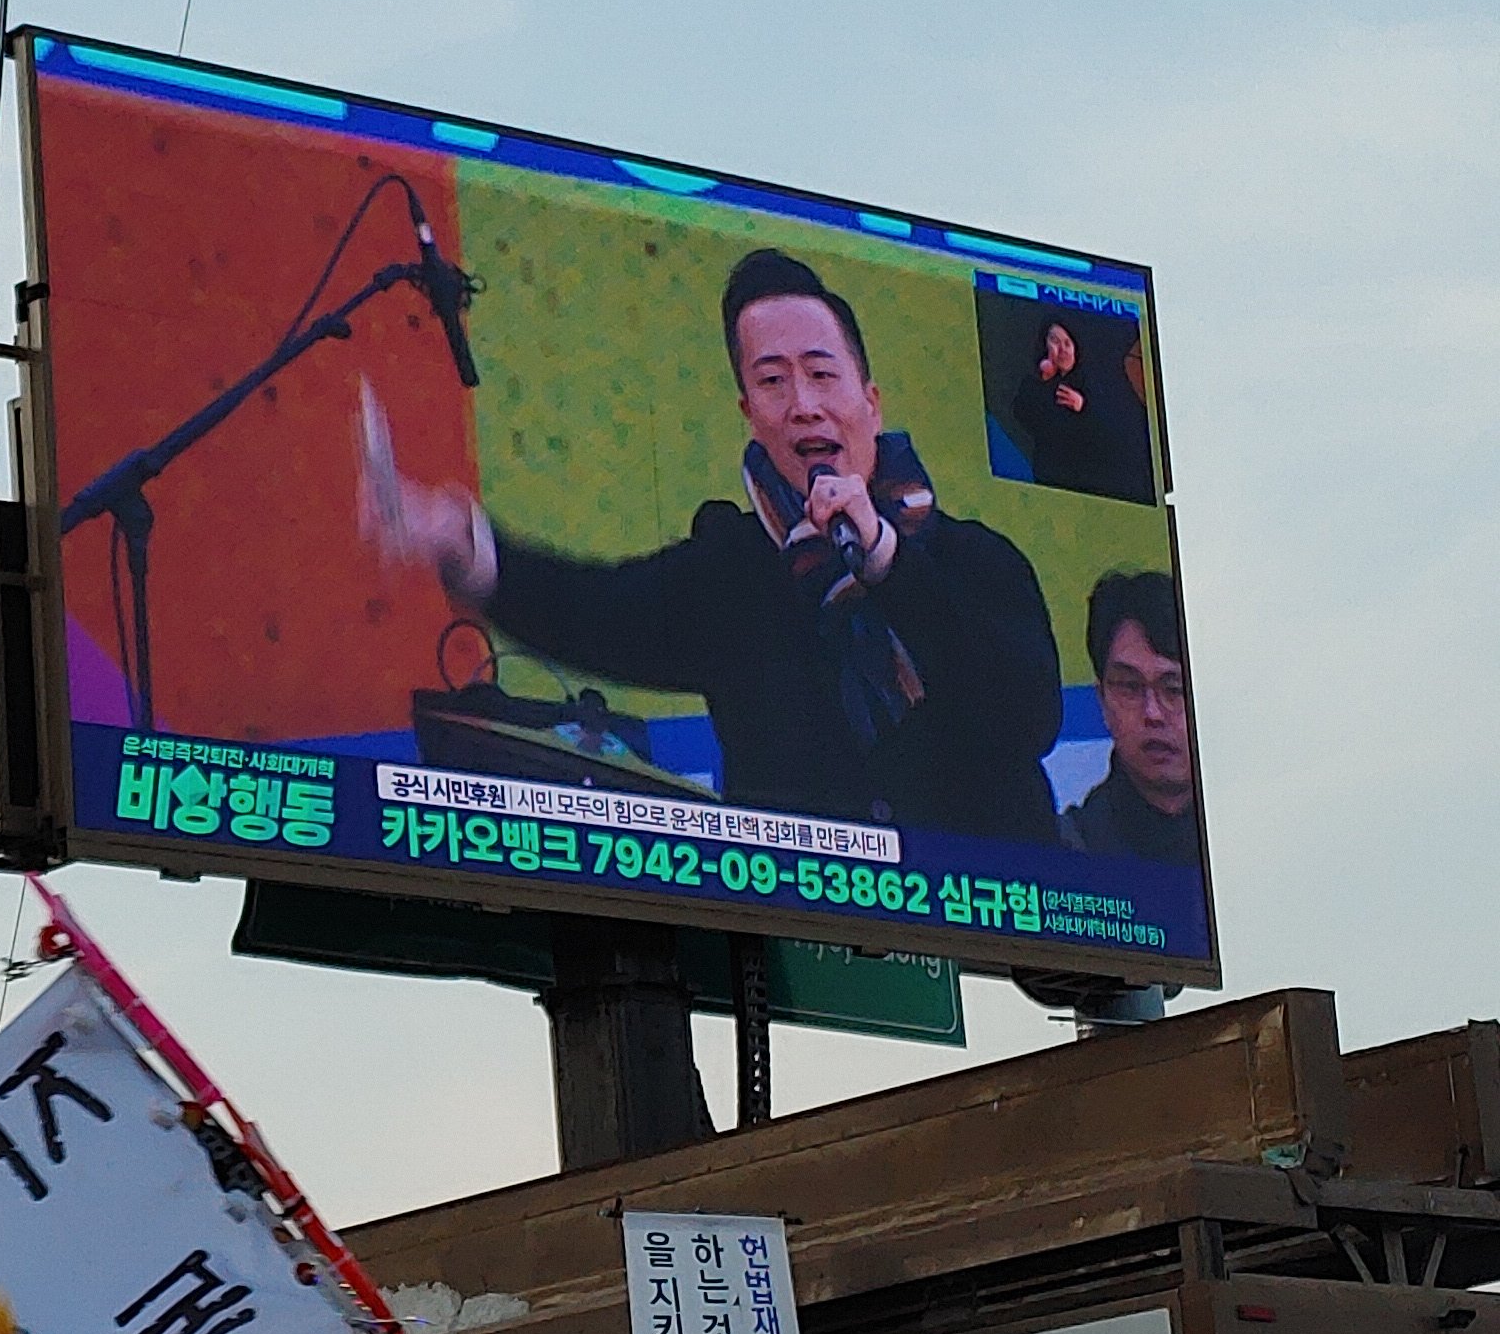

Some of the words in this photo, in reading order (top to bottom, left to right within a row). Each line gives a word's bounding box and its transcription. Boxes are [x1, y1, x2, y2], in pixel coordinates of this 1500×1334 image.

[117, 762, 336, 847] 비상행동
[392, 772, 430, 801] 공식
[432, 779, 507, 809] 시민후원
[518, 788, 553, 815] 시민
[557, 793, 611, 822] 모두의
[613, 799, 667, 827] 힘으로
[670, 807, 722, 836] 윤석열
[724, 814, 760, 842] 탄핵
[763, 819, 813, 848] 집회를
[381, 805, 583, 873] 카카오뱅크
[587, 831, 932, 916] 7942-09-53862
[937, 873, 1042, 933] 심규협
[642, 1231, 676, 1269] 을
[690, 1233, 730, 1305] 하는
